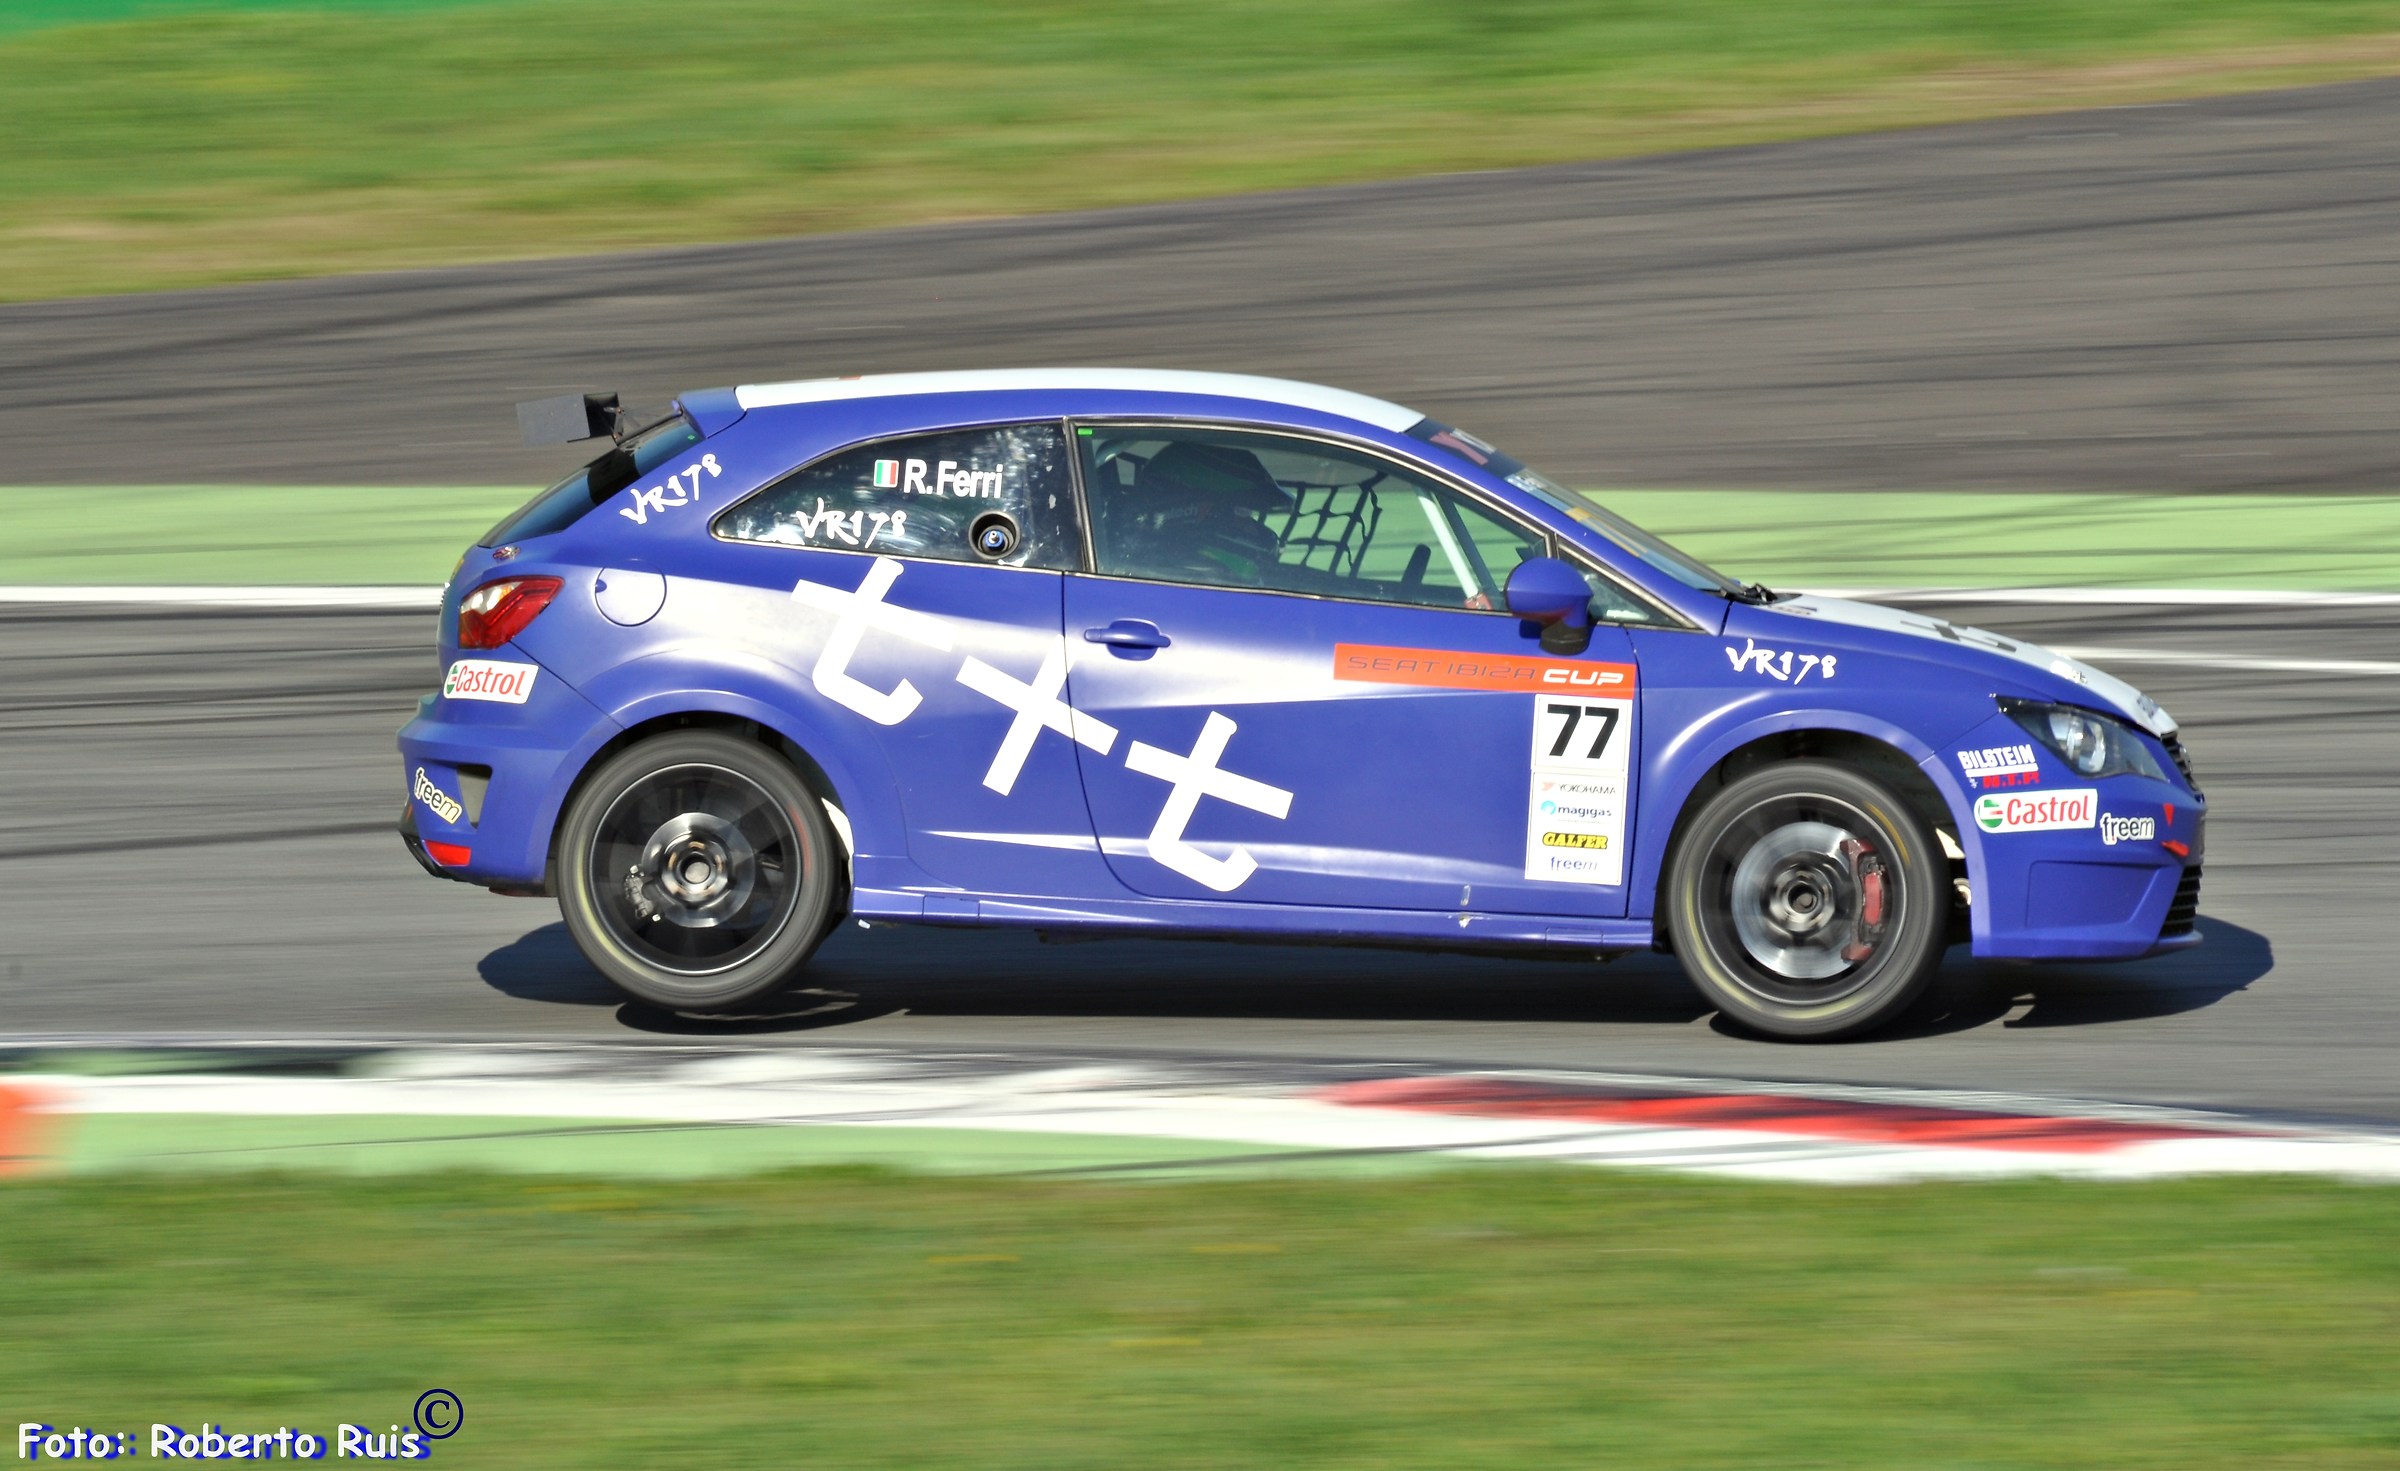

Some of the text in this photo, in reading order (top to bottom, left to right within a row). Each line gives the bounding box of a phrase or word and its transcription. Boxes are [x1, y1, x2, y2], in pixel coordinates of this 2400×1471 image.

[903, 458, 1004, 499] R.Ferri
[456, 665, 526, 696] Castrol
[1348, 656, 1625, 686] SEAT IBIZA CUP
[1547, 703, 1620, 760] 77
[1957, 743, 2037, 770] BILSTEIN
[415, 769, 461, 822] freem
[1559, 783, 1617, 795] YOKOHAMA
[1558, 805, 1612, 818] magigas
[2006, 795, 2091, 825] Castrol
[1542, 831, 1608, 850] GALFER
[2102, 814, 2155, 844] freem
[1550, 856, 1598, 871] freem
